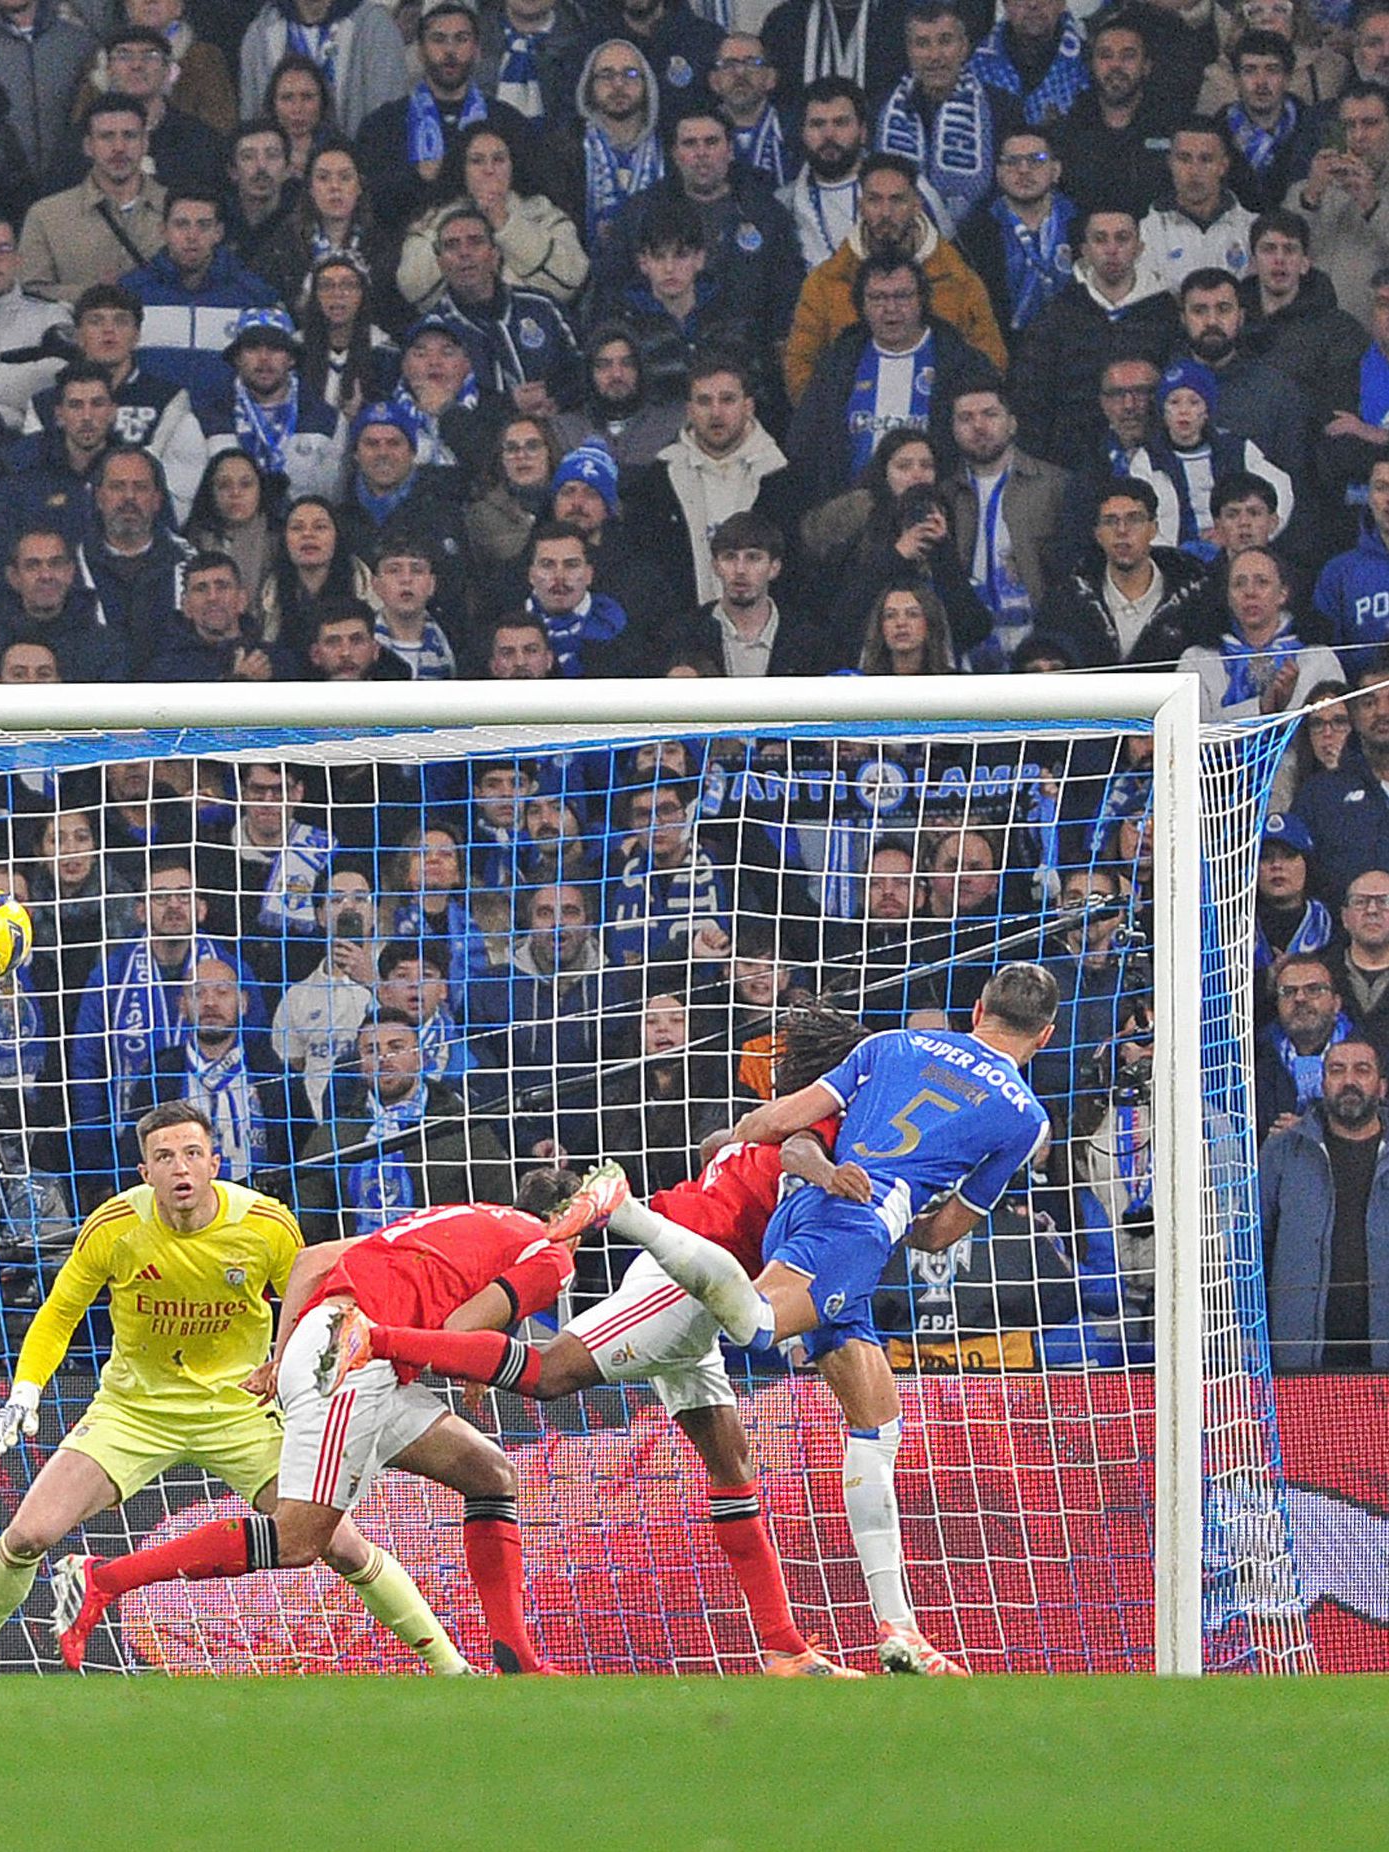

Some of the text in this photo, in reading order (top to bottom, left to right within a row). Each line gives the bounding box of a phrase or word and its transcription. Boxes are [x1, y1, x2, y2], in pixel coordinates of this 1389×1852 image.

[730, 769, 848, 801] ANTI
[912, 1036, 976, 1069] SUPER
[971, 1060, 1032, 1114] BOCK
[851, 1088, 961, 1158] 5
[136, 1293, 249, 1318] Emirates
[151, 1318, 232, 1336] FLY BETTER
